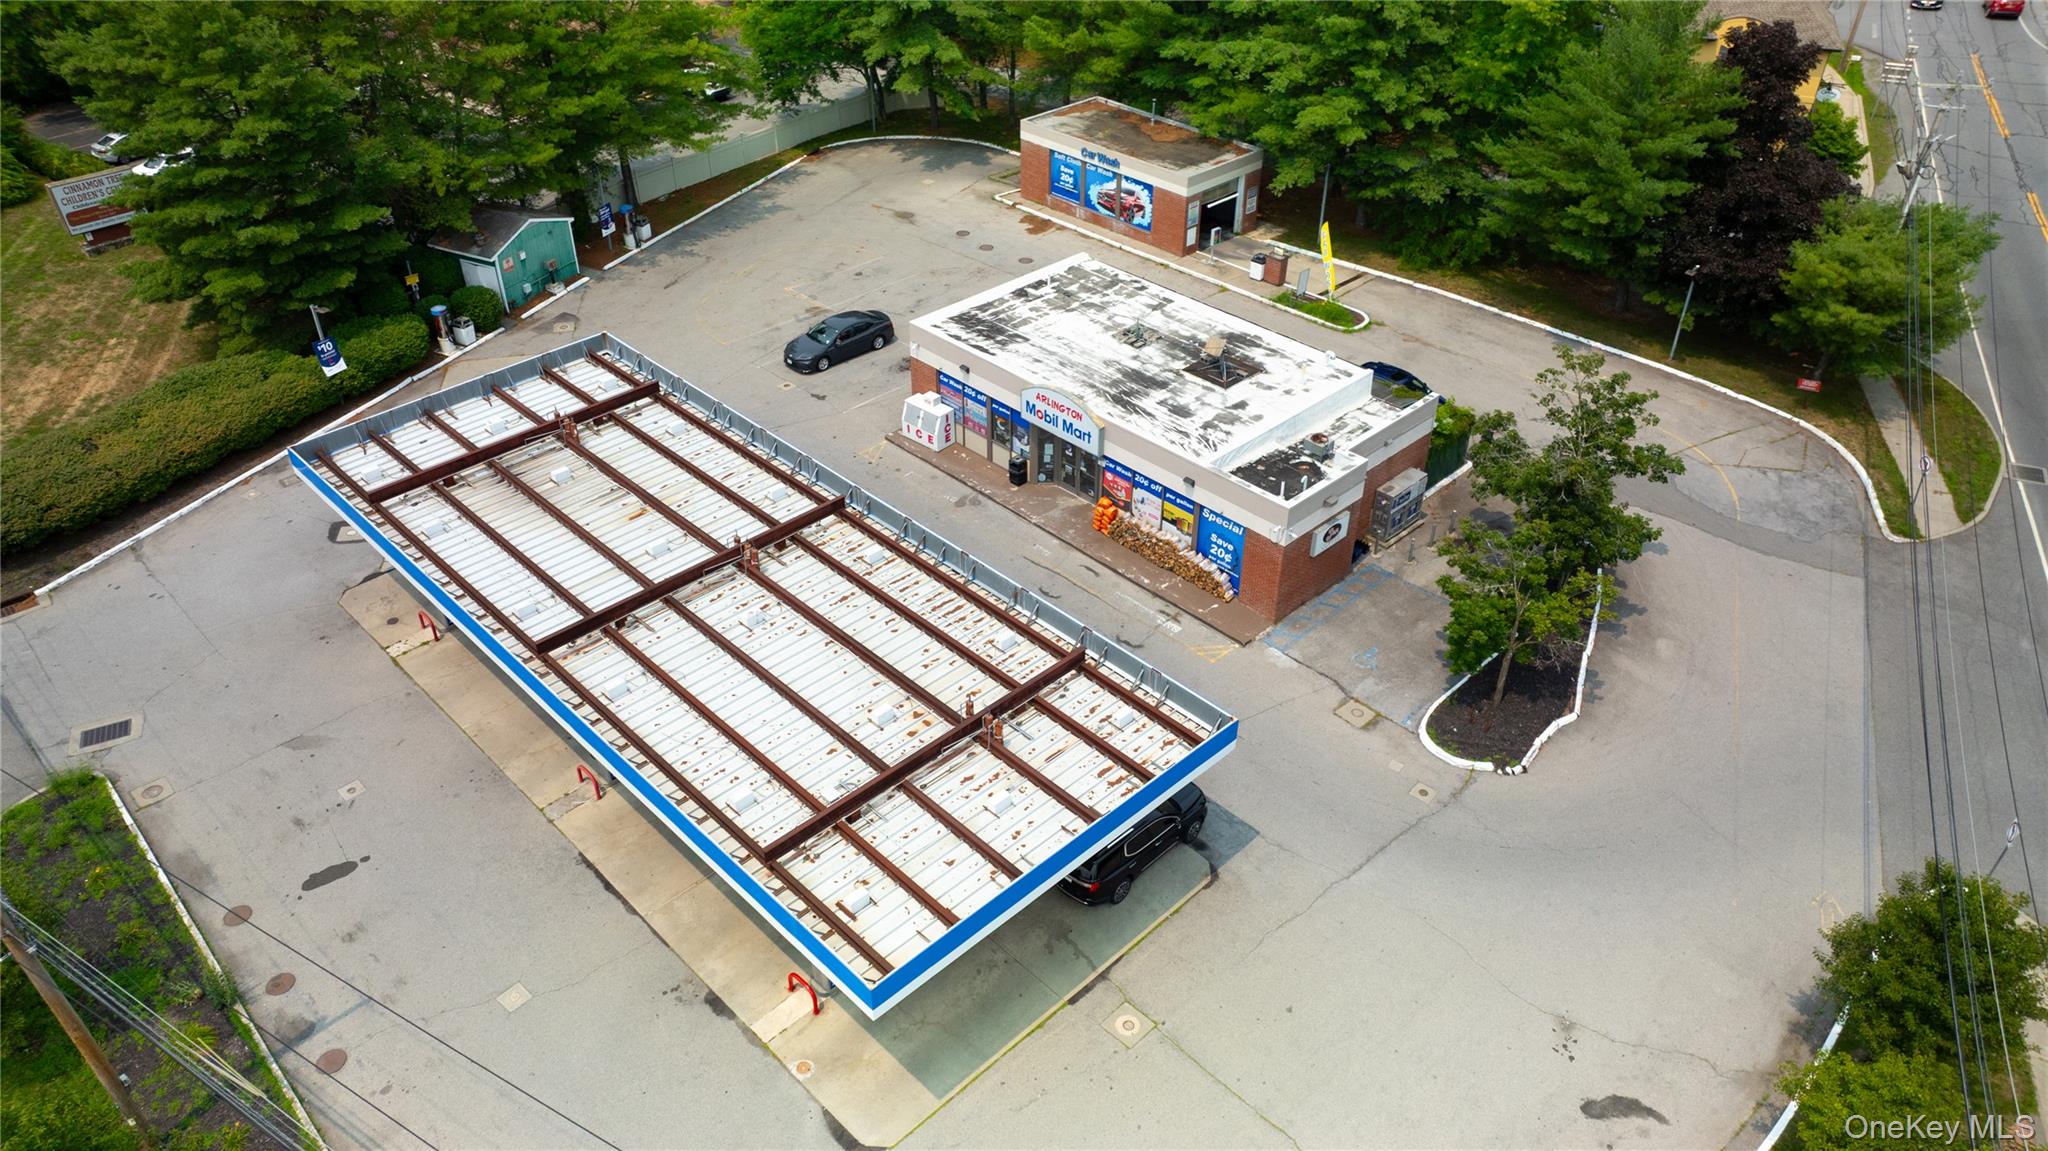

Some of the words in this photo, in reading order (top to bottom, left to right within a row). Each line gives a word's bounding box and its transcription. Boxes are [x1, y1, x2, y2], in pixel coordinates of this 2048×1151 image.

[1081, 147, 1096, 159] Car
[1097, 152, 1120, 169] Wash
[1060, 165, 1074, 175] Save
[61, 189, 105, 206] CHILDREN'S
[62, 178, 104, 195] CINNAMON
[939, 375, 949, 383] Car
[949, 378, 963, 390] Wash
[964, 386, 976, 397] 20¢
[977, 392, 987, 402] off
[1036, 393, 1083, 421] ARLINGTON
[1026, 400, 1058, 428] Mobil
[1062, 419, 1092, 444] Mart
[1104, 460, 1115, 468] Car
[1116, 464, 1132, 477] Wash
[1134, 474, 1149, 486] 20¢
[1150, 483, 1162, 493] off
[1202, 508, 1244, 535] Special
[1210, 533, 1234, 551] Save
[1210, 544, 1232, 563] 20¢
